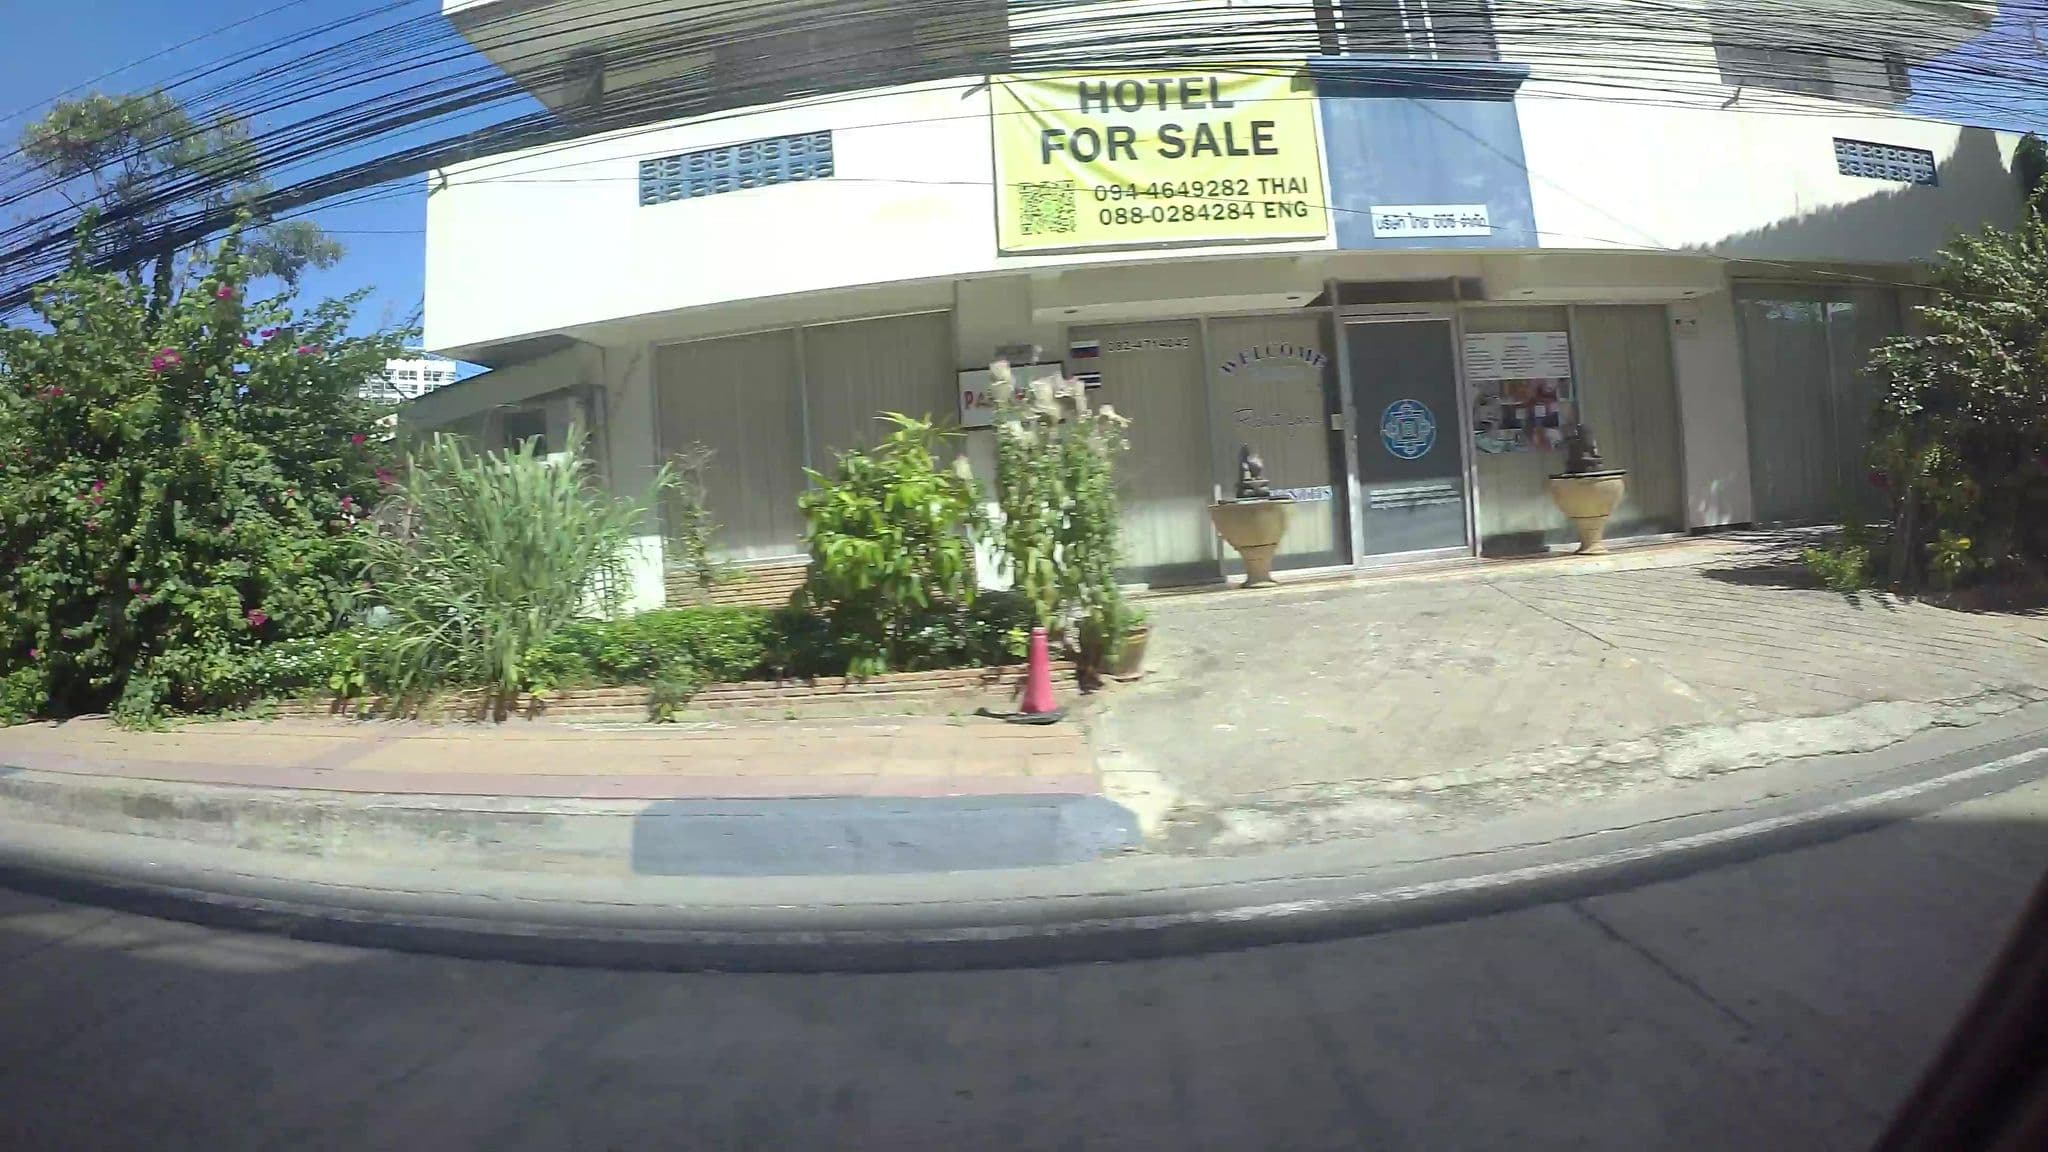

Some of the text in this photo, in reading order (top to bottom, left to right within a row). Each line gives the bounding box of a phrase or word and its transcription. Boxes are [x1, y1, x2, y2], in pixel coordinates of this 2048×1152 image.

[1078, 76, 1235, 114] HOTEL
[1041, 120, 1279, 164] FOR SALE
[1257, 176, 1308, 195] THAI
[1099, 200, 1308, 225] 088-0284284 ENG
[1218, 342, 1328, 374] WELCOME
